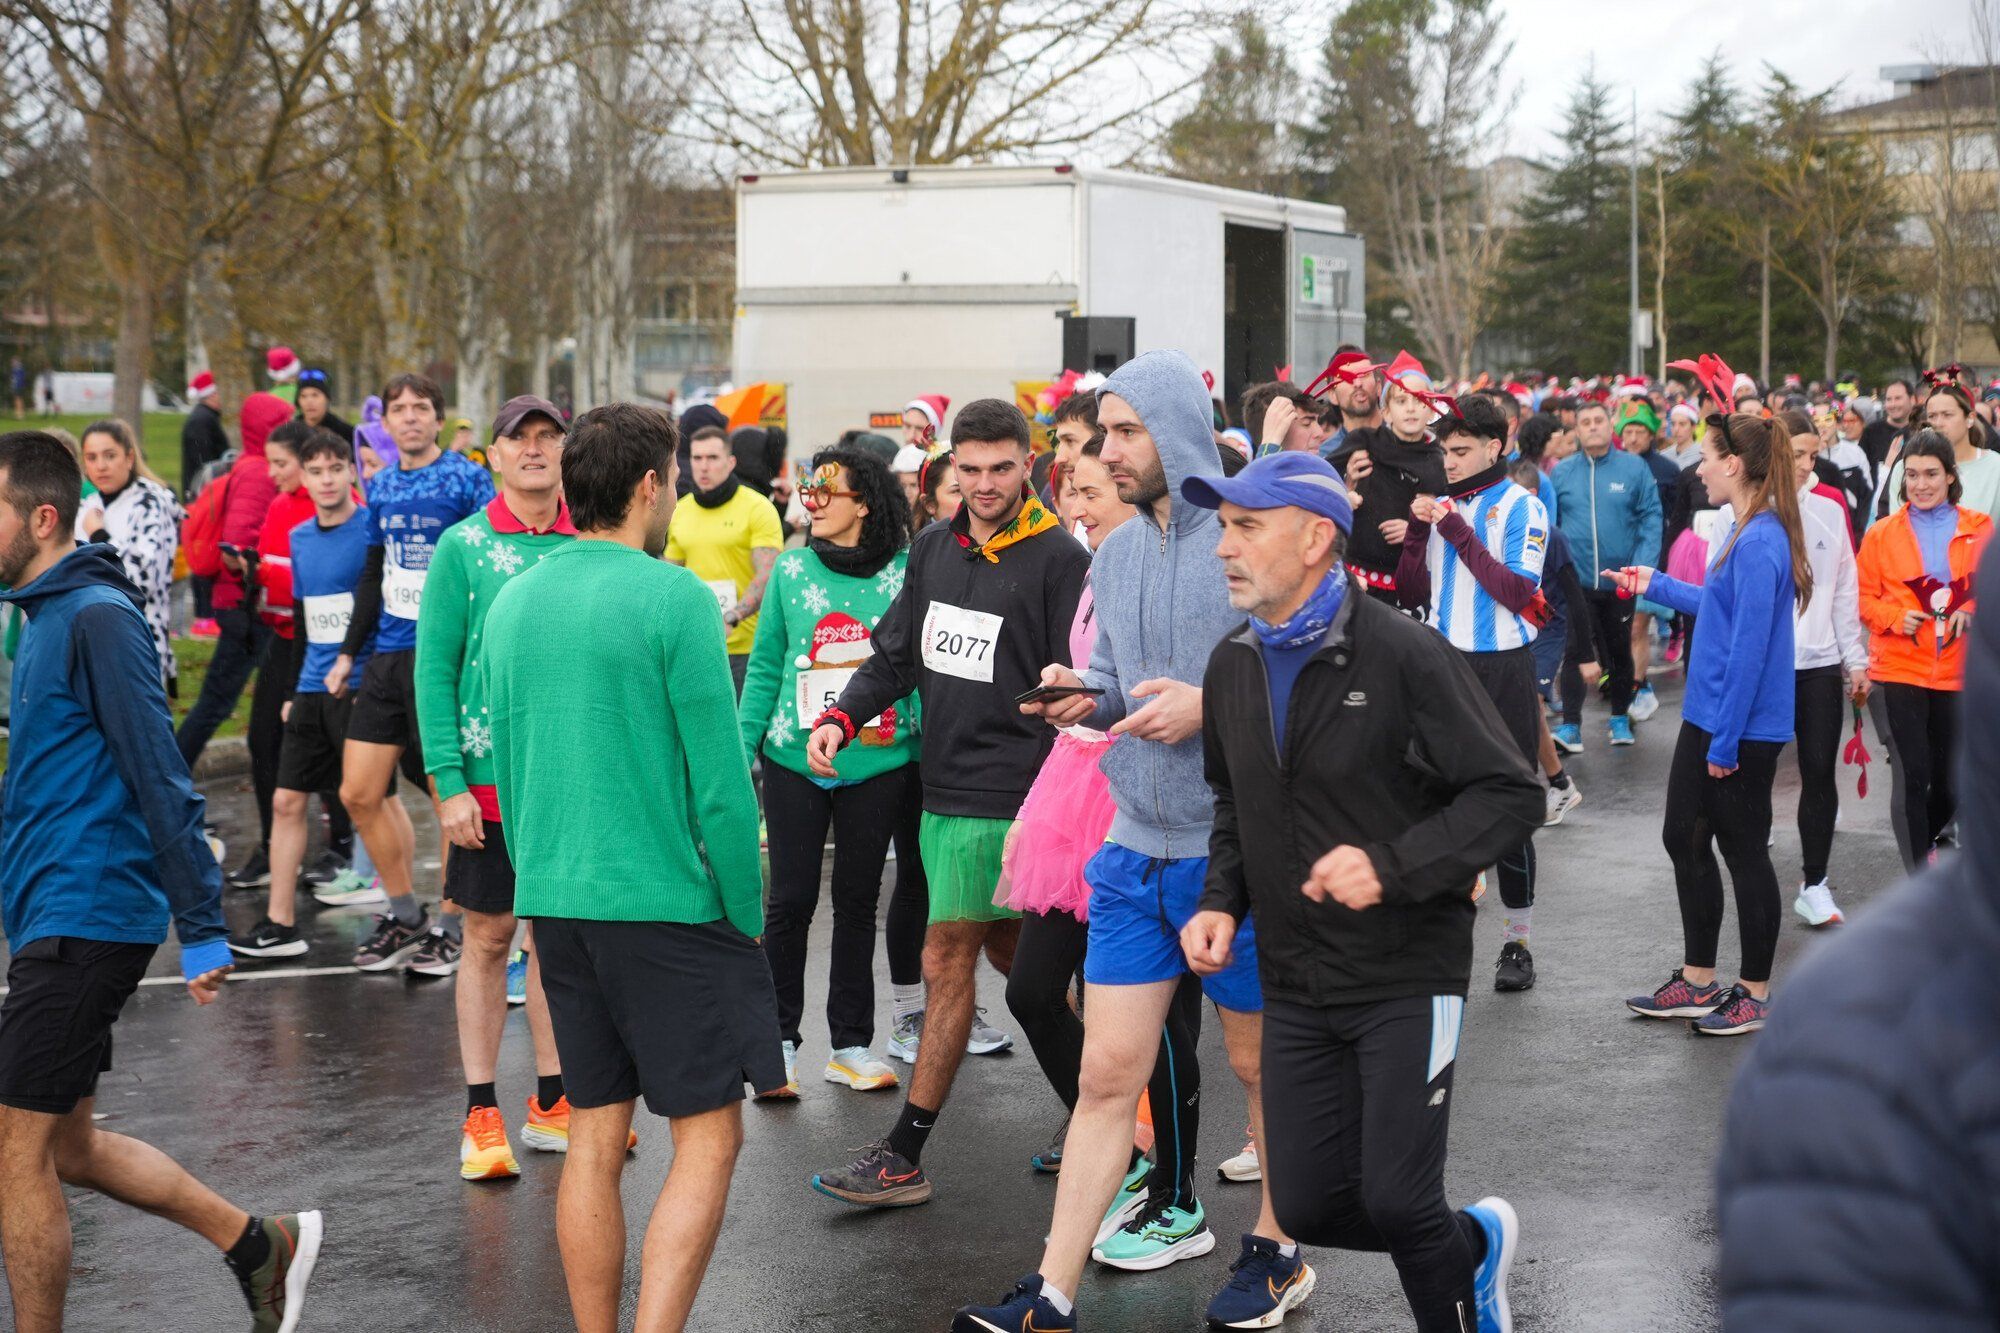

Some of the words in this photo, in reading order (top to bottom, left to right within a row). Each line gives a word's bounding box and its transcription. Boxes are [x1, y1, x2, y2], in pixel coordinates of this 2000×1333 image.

[404, 543, 435, 553] VITORI
[394, 587, 423, 606] 190
[719, 595, 728, 608] 2
[311, 611, 352, 630] 1903
[935, 630, 991, 662] 2077
[823, 691, 837, 709] 5
